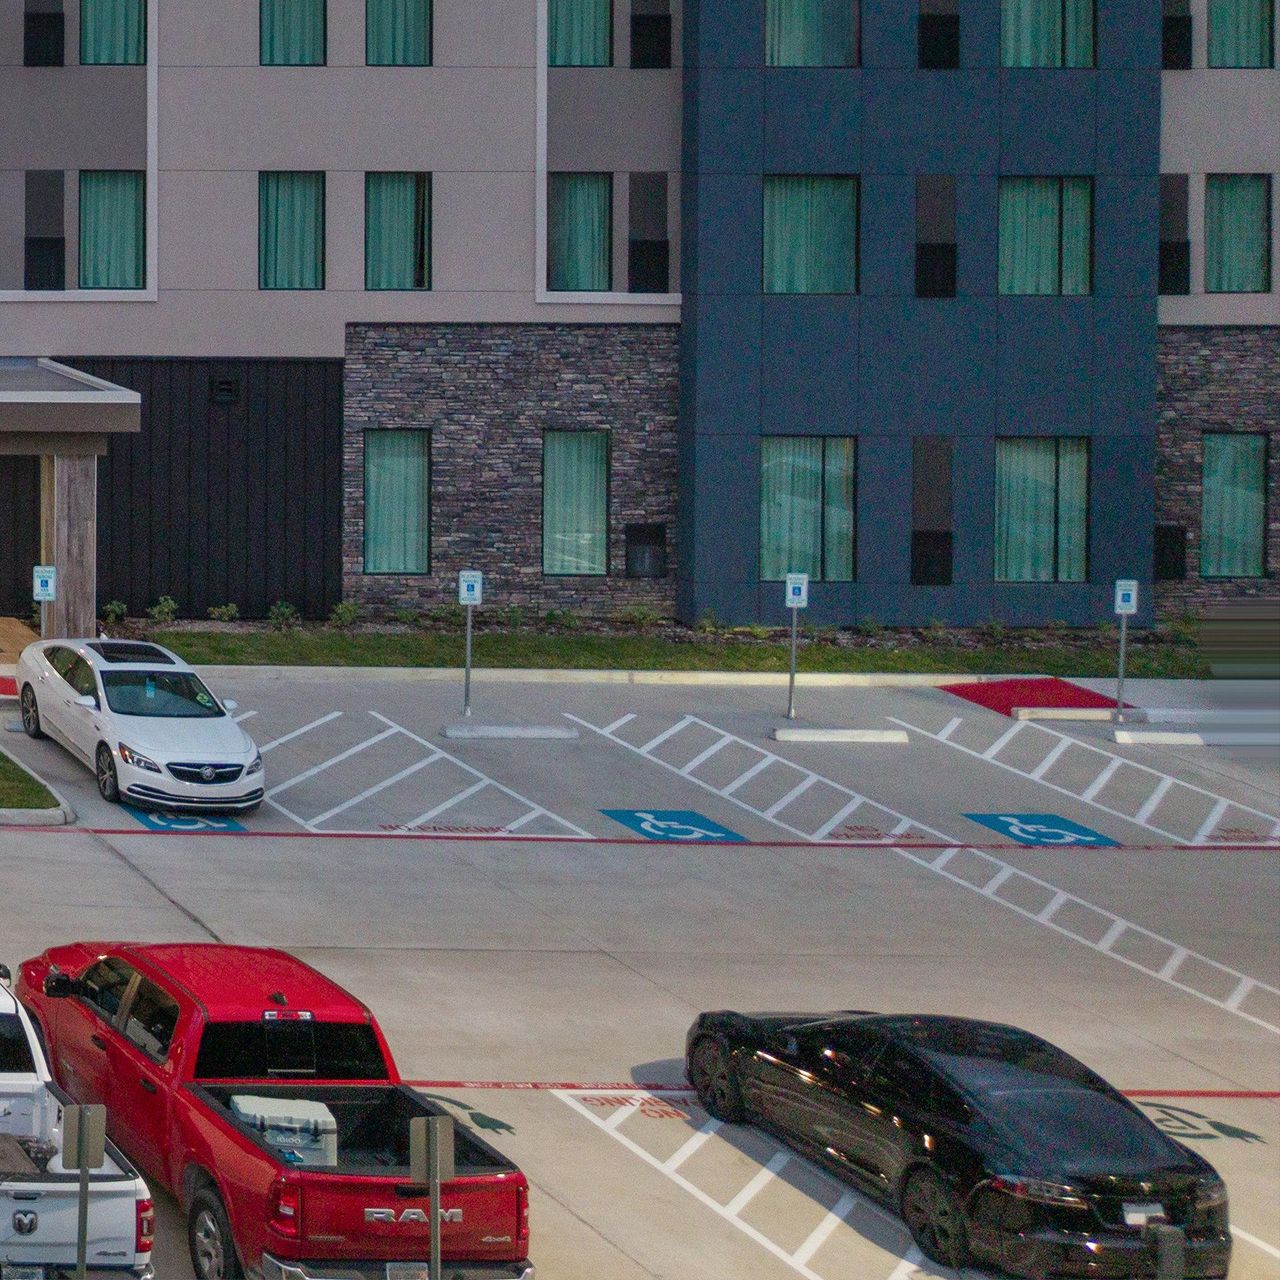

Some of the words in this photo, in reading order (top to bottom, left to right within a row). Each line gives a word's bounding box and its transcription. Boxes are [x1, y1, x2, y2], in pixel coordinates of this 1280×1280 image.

[416, 825, 513, 833] PARKING
[640, 1108, 691, 1120] NO
[364, 1208, 463, 1222] RAM
